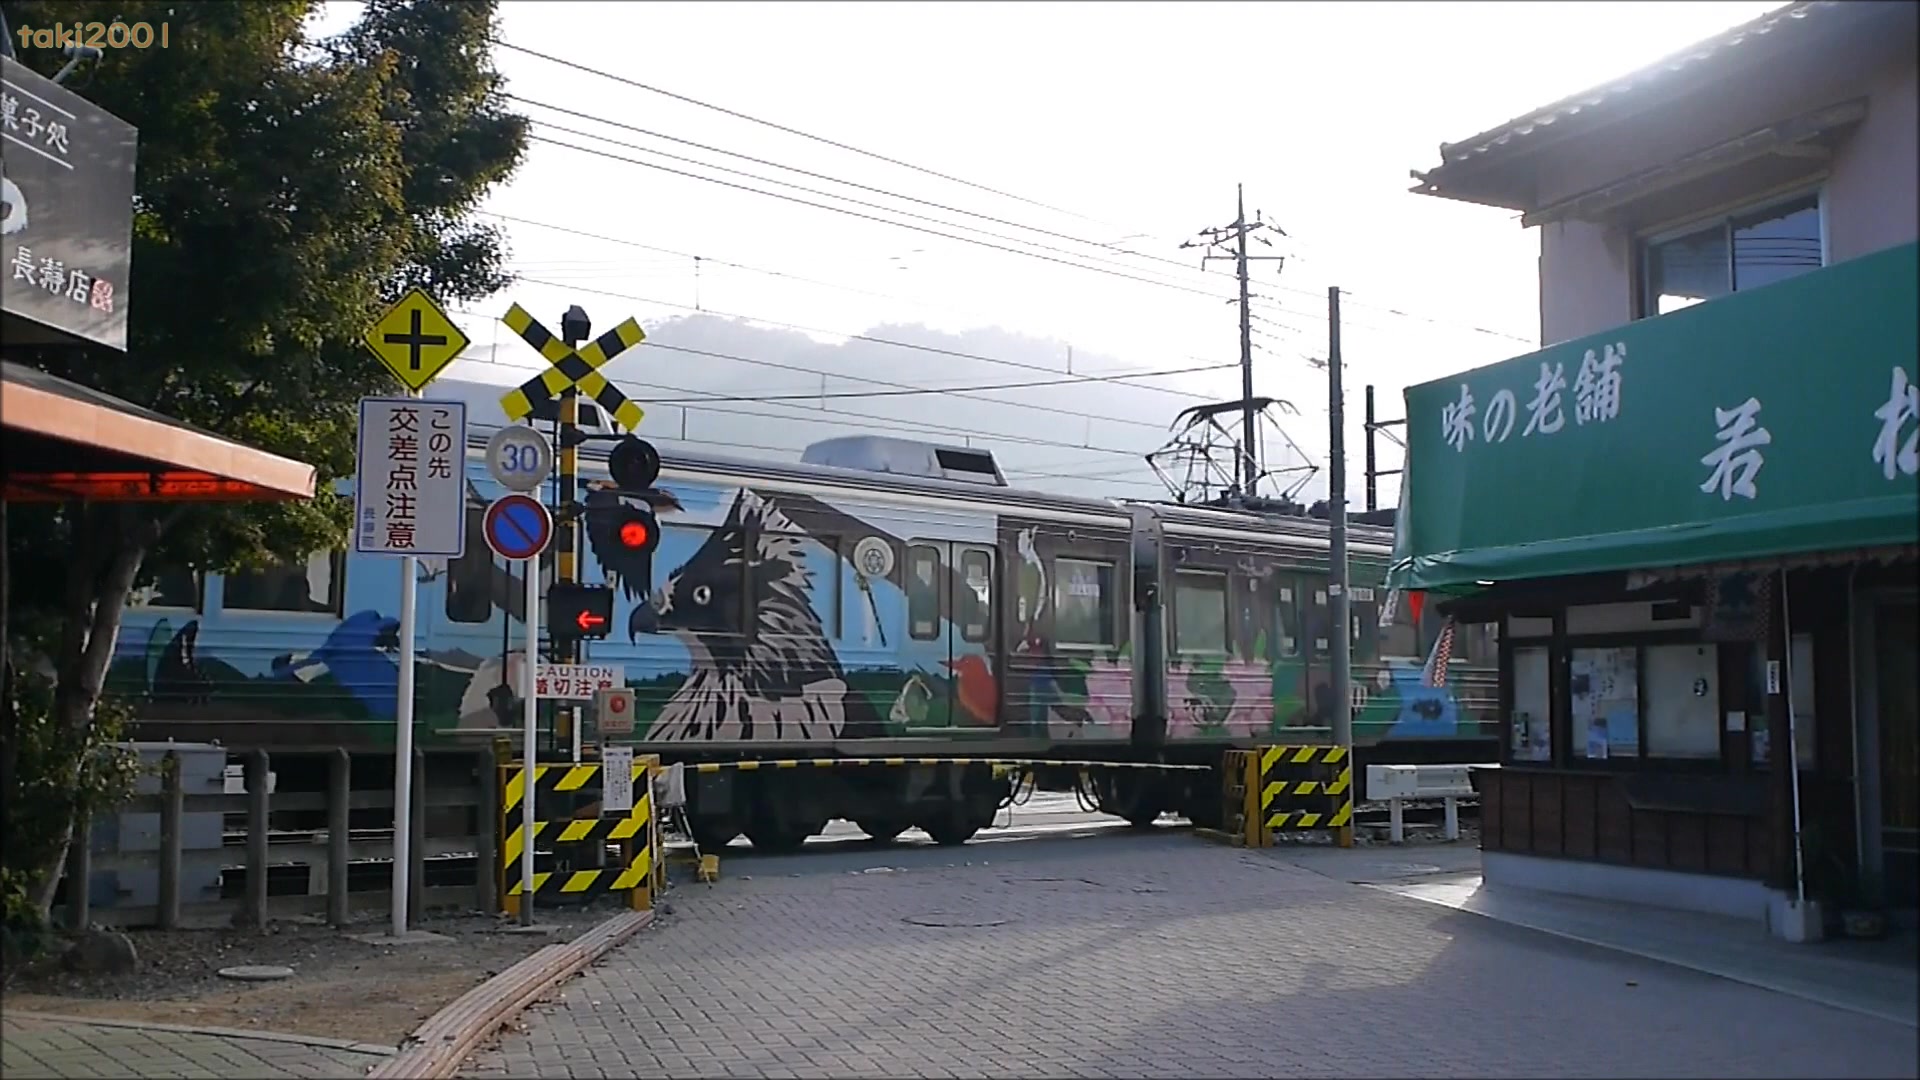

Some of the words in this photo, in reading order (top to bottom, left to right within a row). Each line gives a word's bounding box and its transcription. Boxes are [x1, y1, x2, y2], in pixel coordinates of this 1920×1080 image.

[1442, 342, 1626, 452] 味の老舗
[385, 406, 419, 548] 交差点注意
[428, 409, 451, 479] この先
[501, 443, 539, 473] 30
[536, 666, 613, 678] CAUTION
